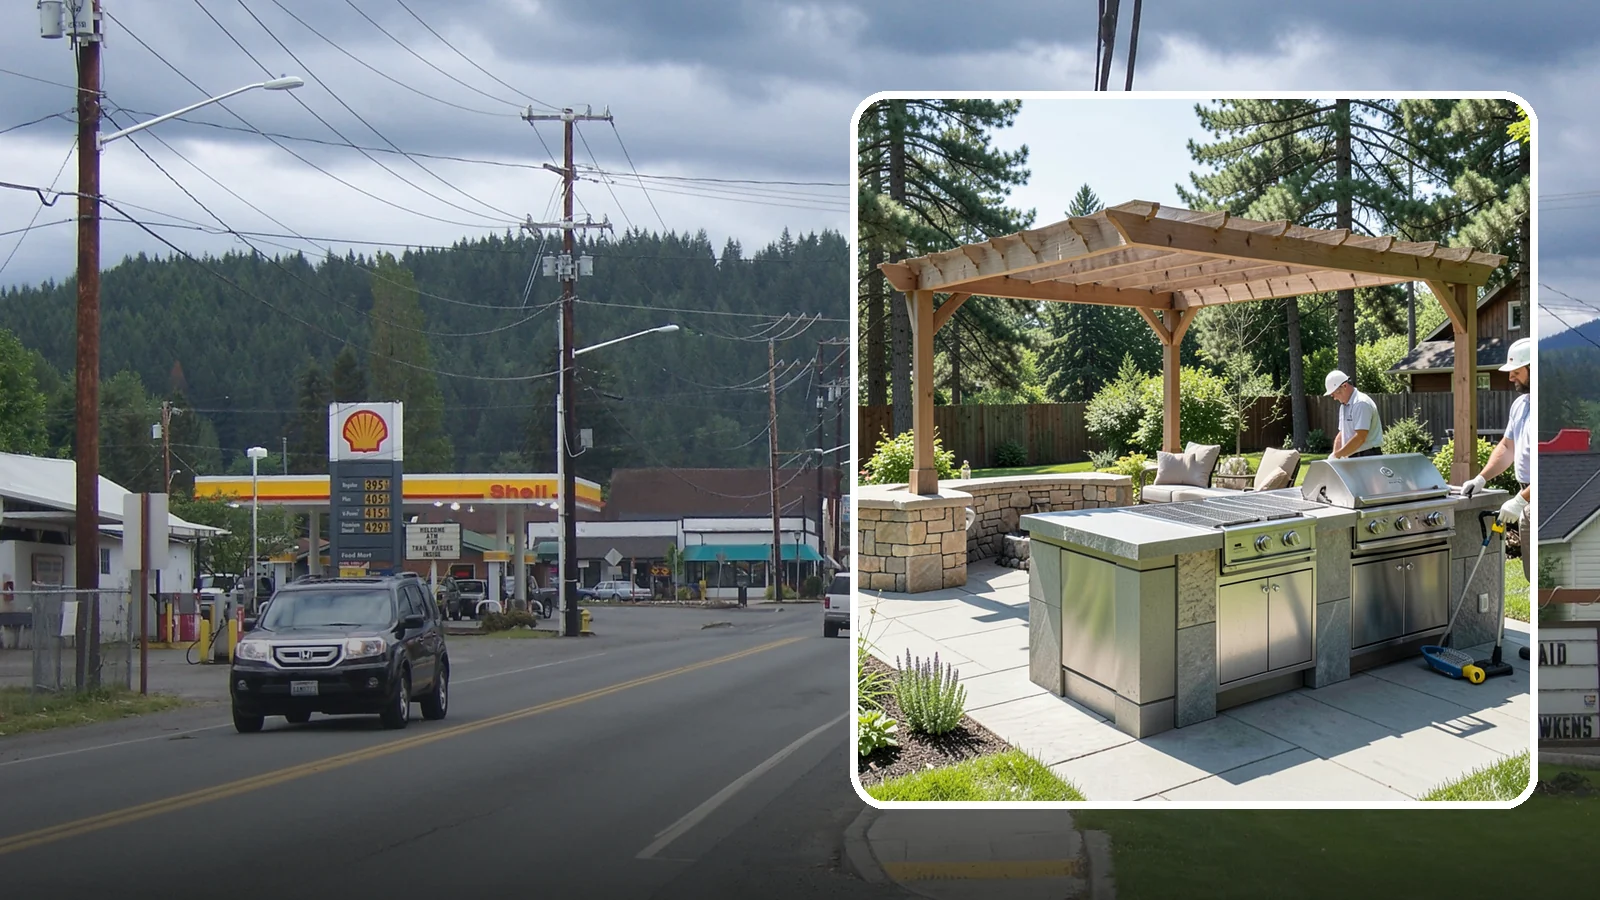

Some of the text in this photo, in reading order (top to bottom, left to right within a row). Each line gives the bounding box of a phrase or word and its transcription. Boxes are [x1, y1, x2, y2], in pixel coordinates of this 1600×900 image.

[365, 480, 383, 490] 395
[490, 484, 547, 499] Shell
[365, 494, 383, 504] 405
[365, 508, 383, 518] 415
[365, 522, 383, 532] 429
[1539, 642, 1567, 666] AID
